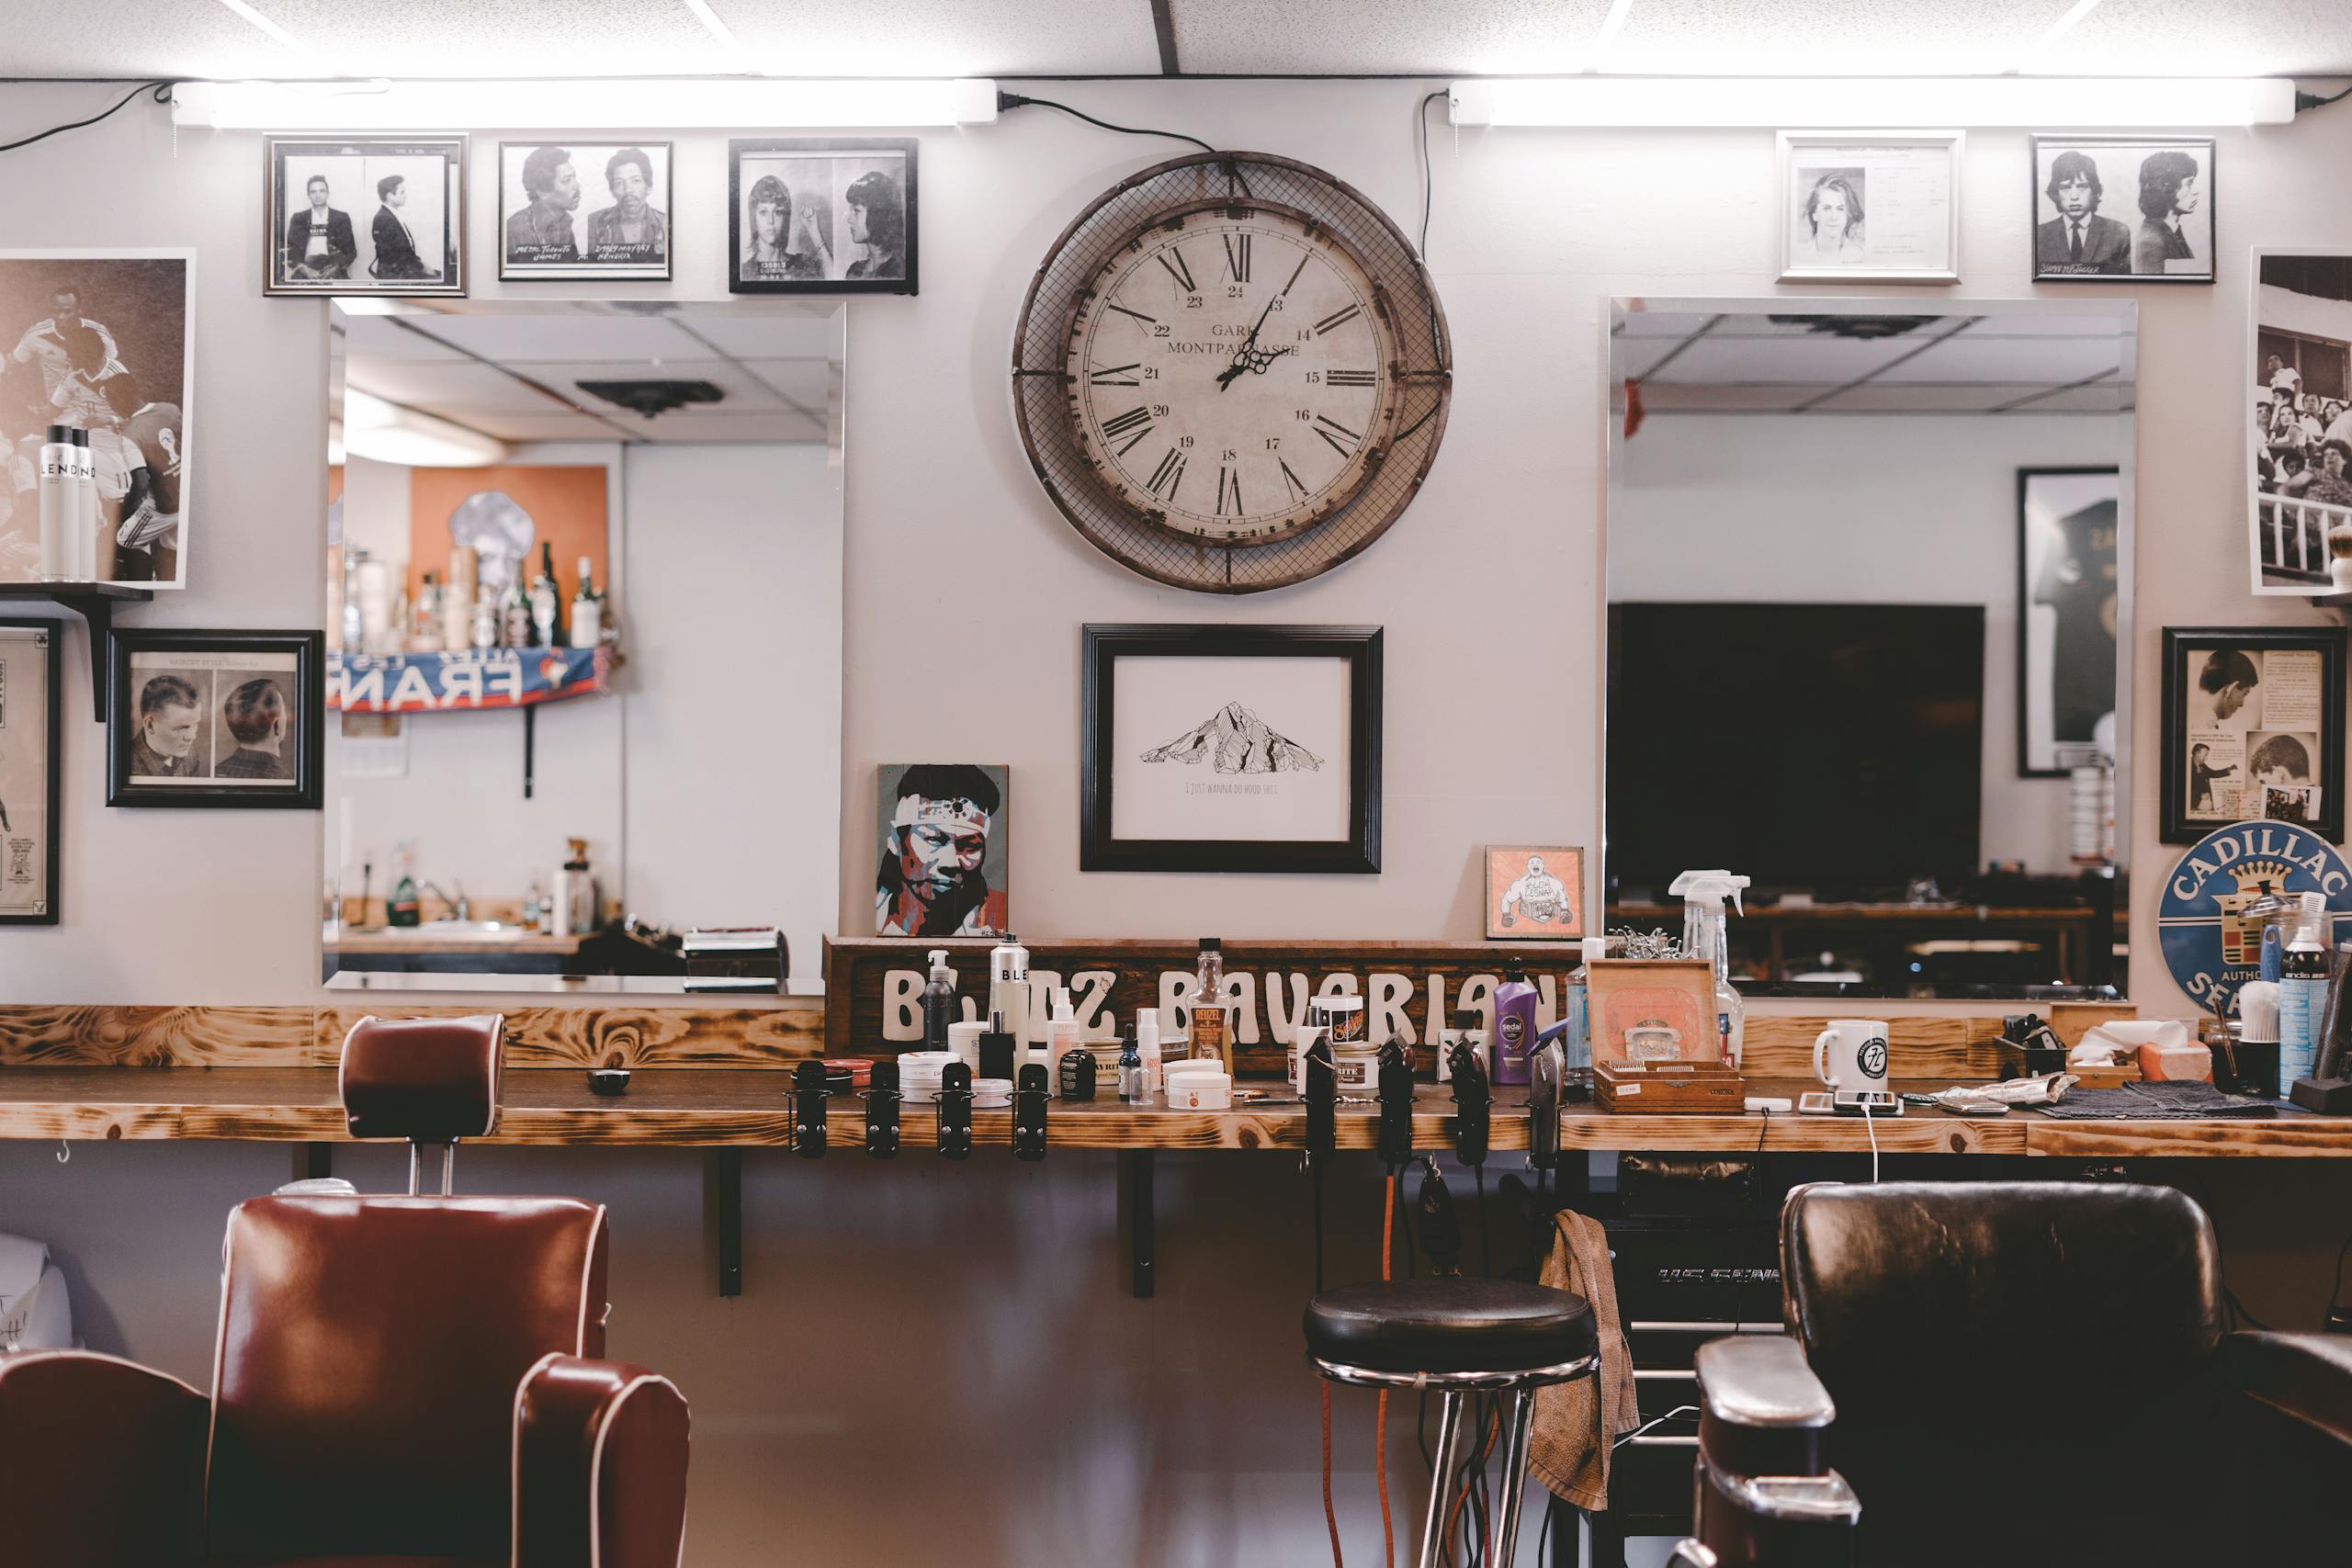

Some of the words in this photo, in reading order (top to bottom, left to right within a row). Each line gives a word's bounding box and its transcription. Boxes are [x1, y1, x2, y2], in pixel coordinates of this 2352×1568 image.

[1219, 233, 1251, 283] XII
[1227, 286, 1244, 299] 24
[1186, 296, 1204, 309] 23
[1154, 324, 1170, 337] 22
[1296, 330, 1311, 341] 14
[1144, 367, 1160, 379] 21
[1305, 371, 1320, 383] 15
[1153, 404, 1170, 416] 20
[1295, 409, 1310, 421] 16
[1180, 435, 1194, 448] 19
[1265, 438, 1281, 450] 17
[1222, 448, 1238, 461] 18
[1185, 782, 1190, 795] I
[1191, 783, 1205, 795] JUST
[1207, 784, 1233, 795] WANNA
[1234, 784, 1243, 795] DO
[1244, 784, 1261, 795] HOOD
[2173, 829, 2349, 901] CADILLAC
[1002, 969, 1027, 980] BLE
[883, 969, 1116, 1043] BTZ
[1196, 1010, 1221, 1021] REUZEL
